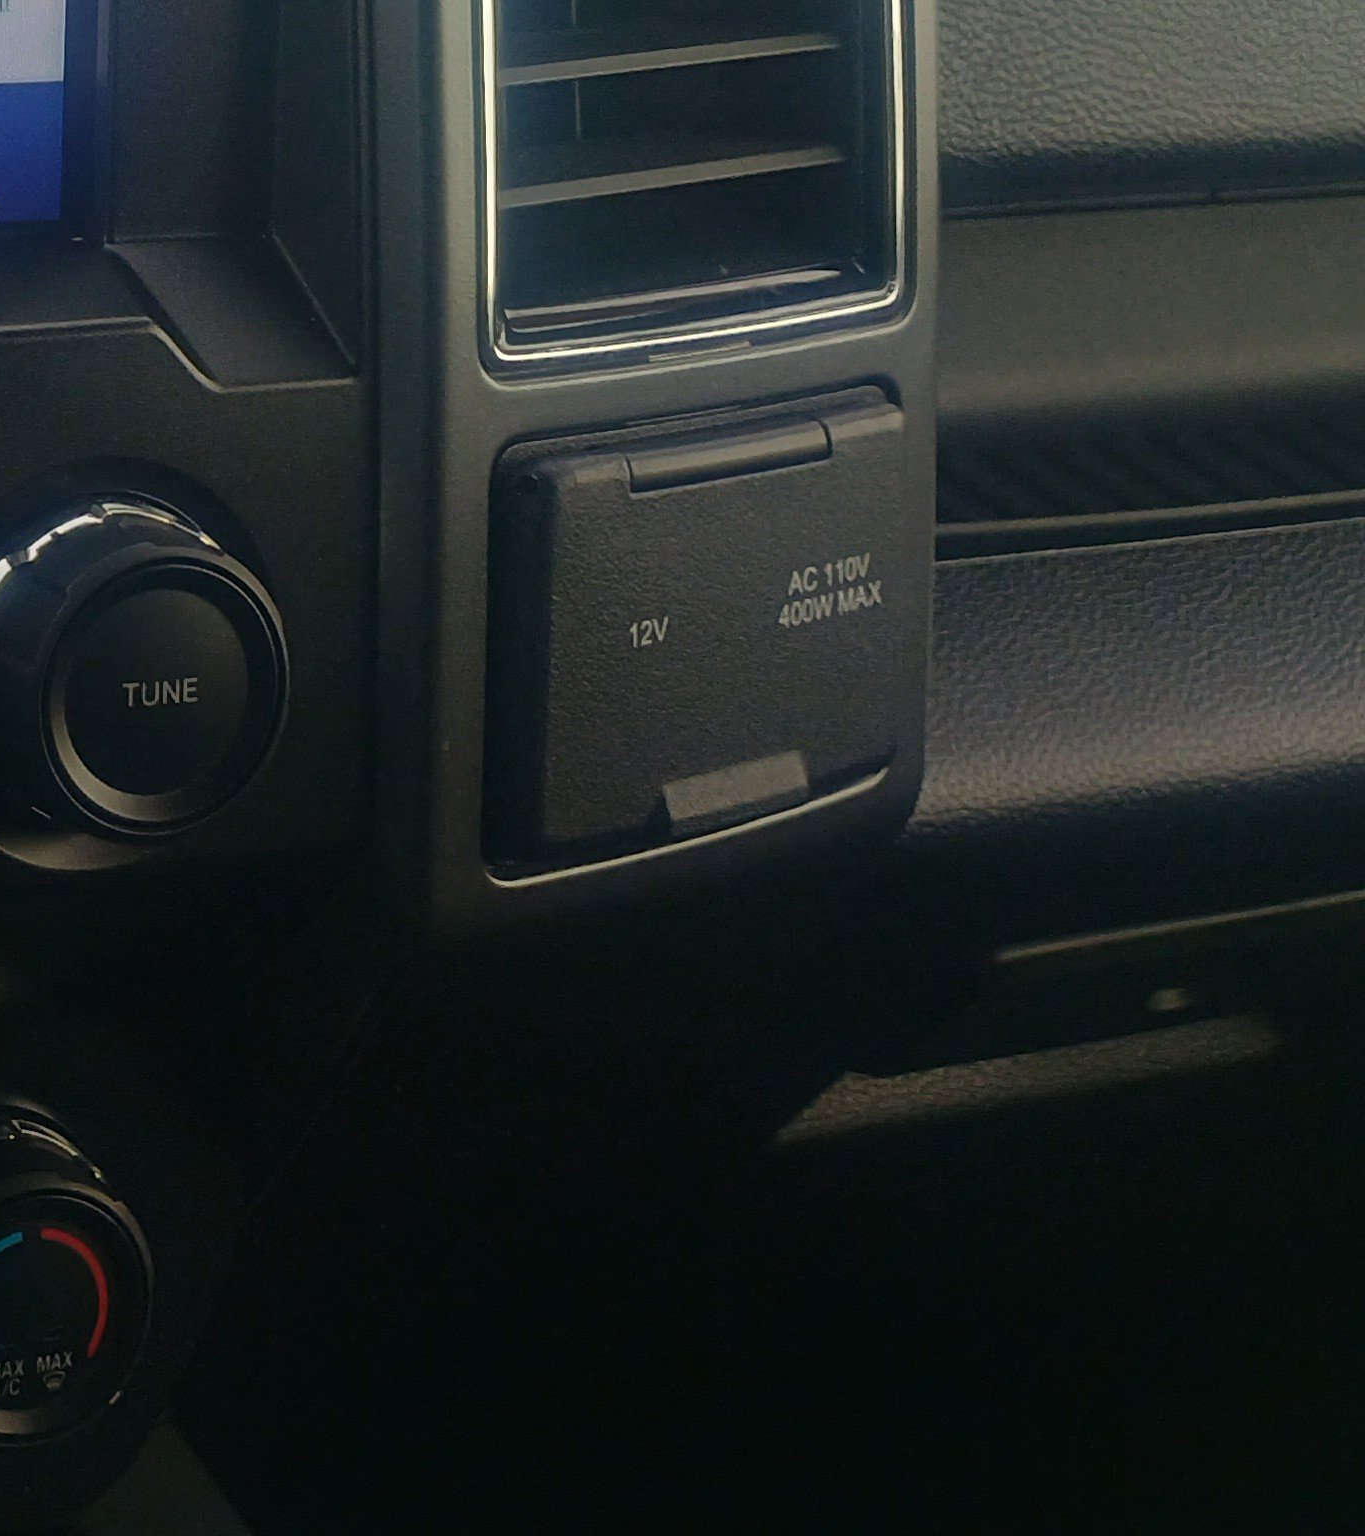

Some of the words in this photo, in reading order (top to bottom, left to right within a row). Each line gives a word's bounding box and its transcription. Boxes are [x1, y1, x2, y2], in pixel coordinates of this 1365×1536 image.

[789, 566, 818, 596] AC
[824, 552, 870, 586] 110V
[778, 593, 834, 629] 400W
[838, 579, 882, 616] MAX
[629, 616, 669, 648] 12V
[122, 677, 199, 707] TUNE
